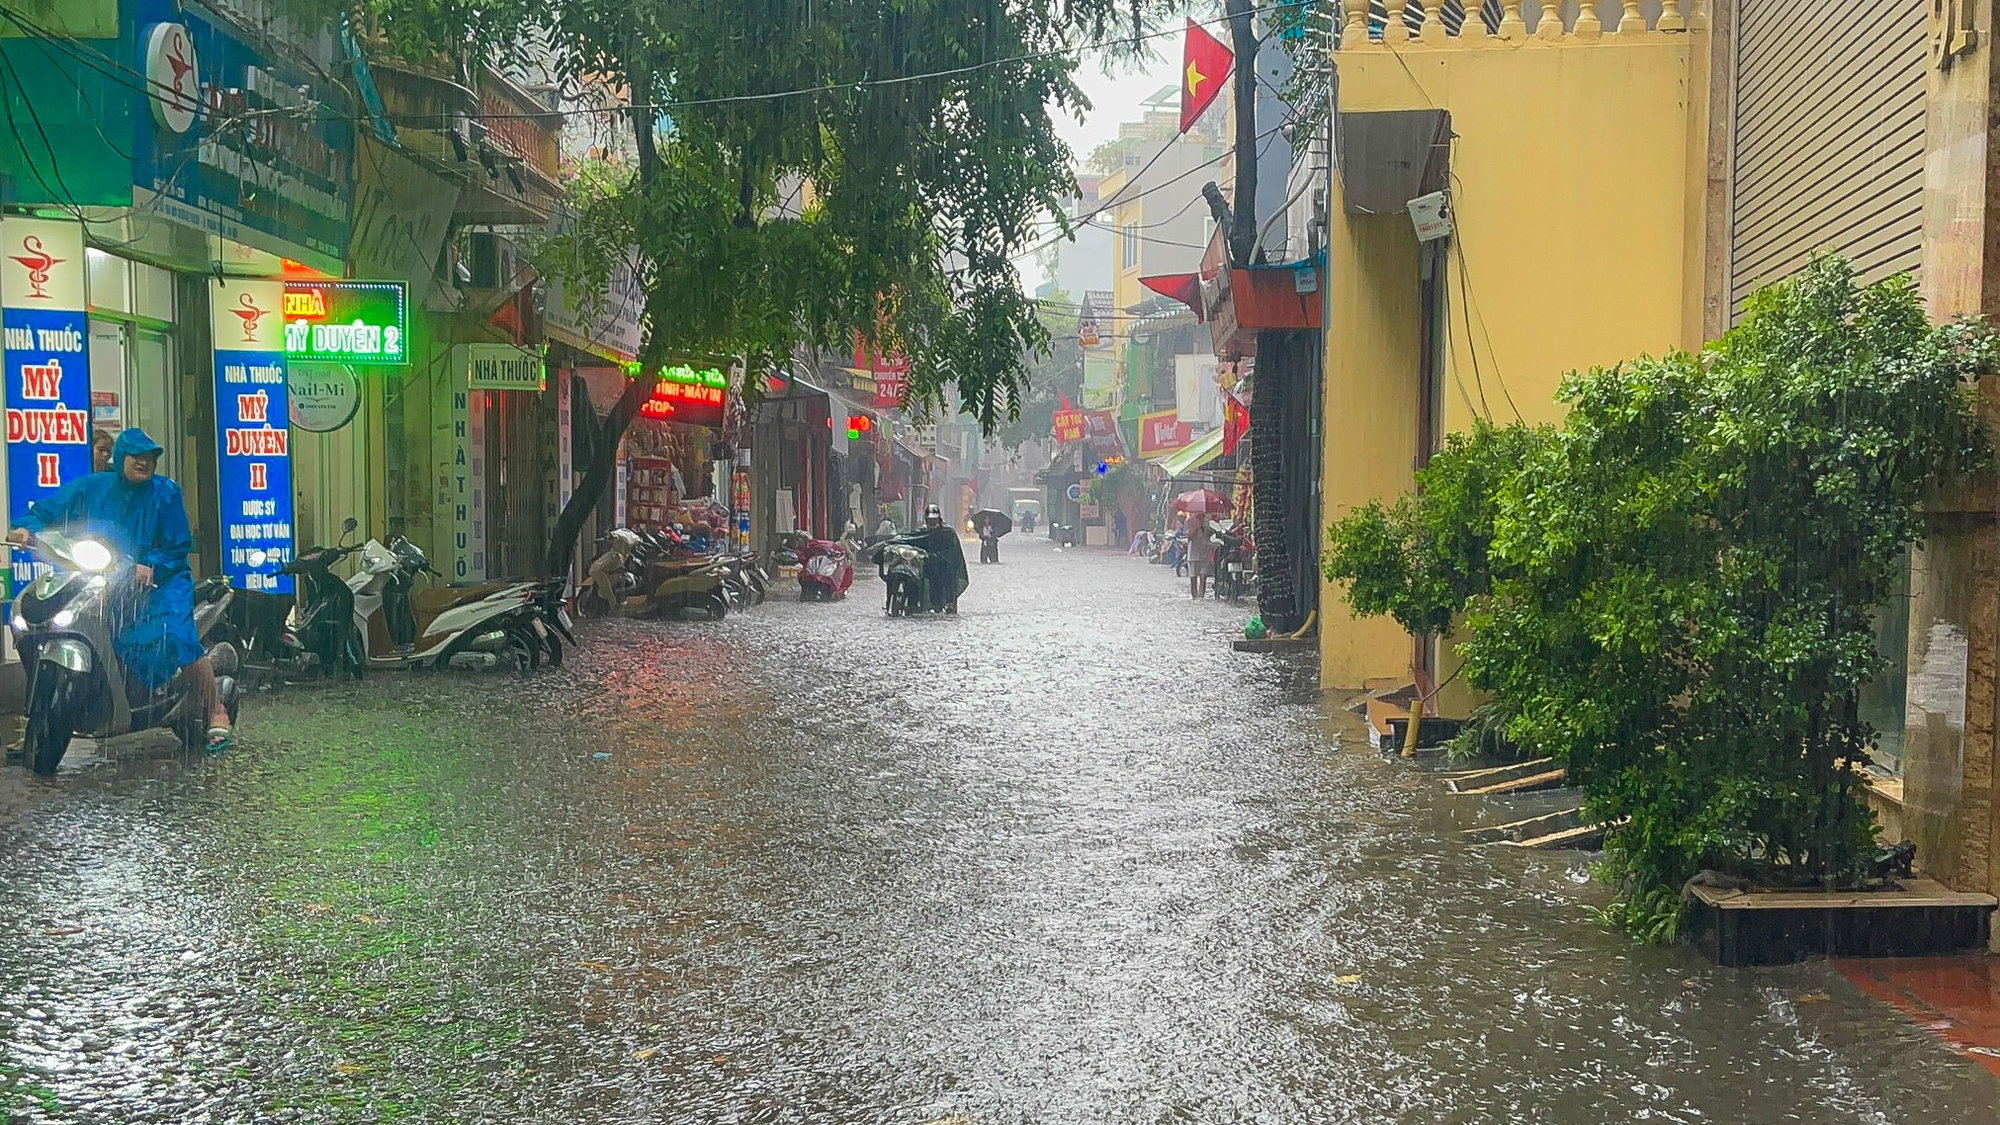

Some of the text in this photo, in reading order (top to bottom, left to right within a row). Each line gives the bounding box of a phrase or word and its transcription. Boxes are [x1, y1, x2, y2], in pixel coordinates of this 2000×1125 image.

[284, 289, 325, 315] NHÀ
[4, 322, 82, 353] NHÀ THUỐC
[313, 320, 381, 353] DUYÊN
[383, 326, 399, 354] 2
[22, 359, 61, 400] MỸ
[224, 361, 282, 384] NHÀ THUỐC
[475, 353, 537, 382] NHÀ THUỐC
[238, 389, 268, 422] MỸ
[684, 383, 708, 400] MÁY
[709, 388, 722, 403] IN
[6, 403, 87, 444] DUYÊN
[226, 423, 288, 456] DUYÊN
[38, 453, 60, 487] II
[250, 463, 267, 490] II
[242, 497, 276, 519] DƯỢC SỸ
[230, 518, 290, 543] ĐẠI HỌC TƯ VẤN
[455, 476, 467, 577] THUỐ
[231, 545, 245, 567] TẬN
[12, 558, 32, 586] TẬN
